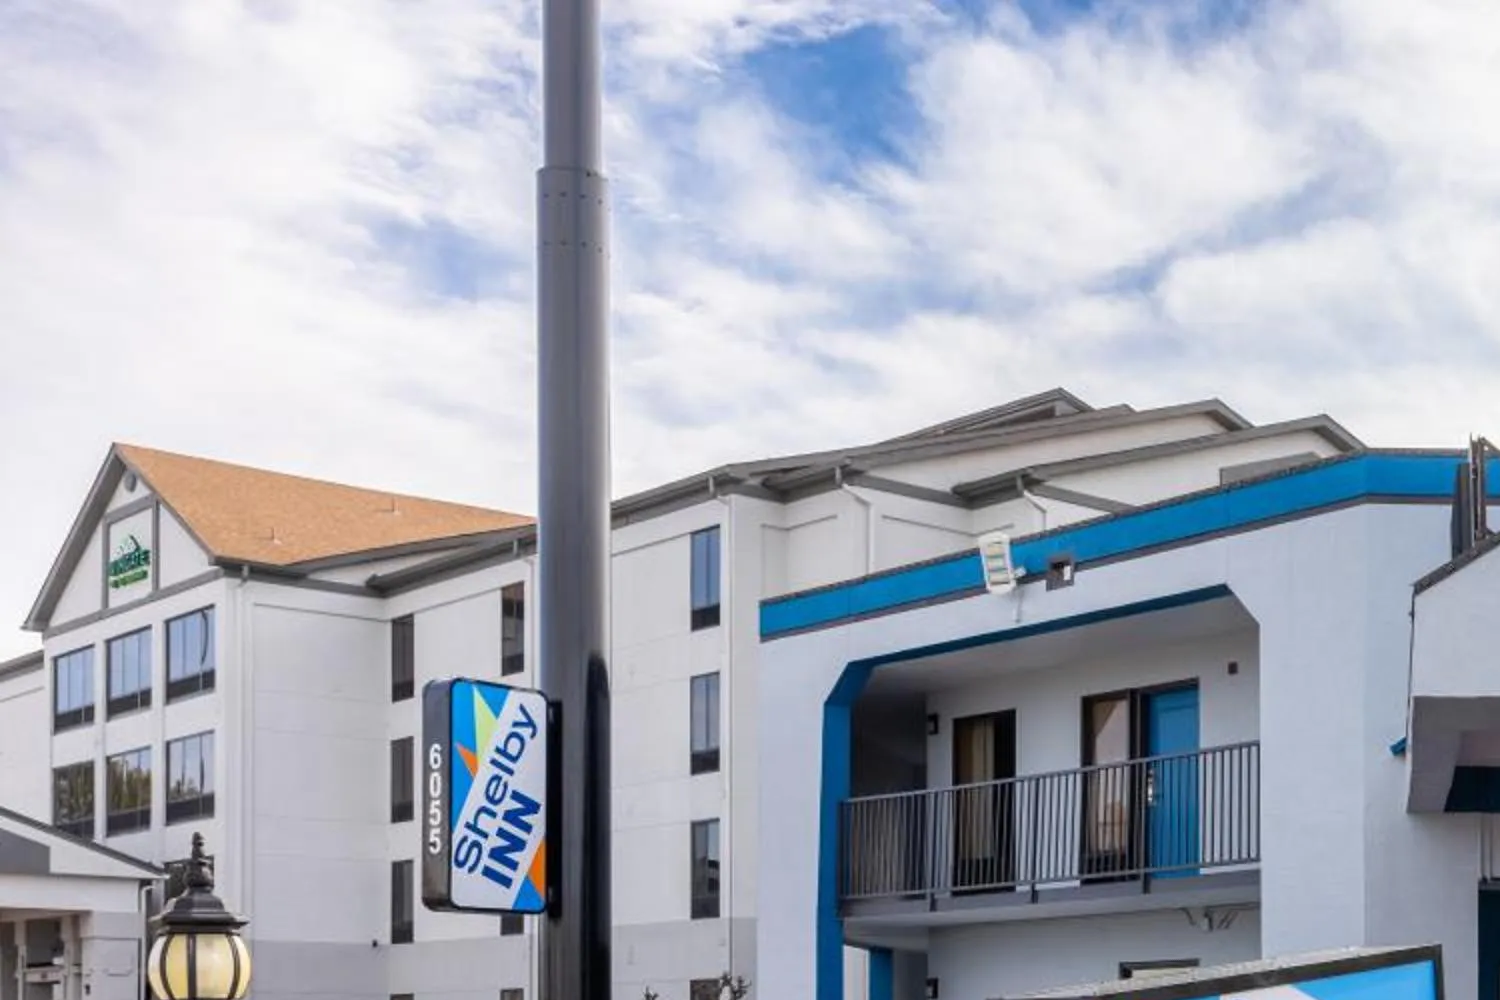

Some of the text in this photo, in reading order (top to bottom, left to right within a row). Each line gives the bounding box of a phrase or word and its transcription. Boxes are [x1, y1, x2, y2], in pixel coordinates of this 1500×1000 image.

[428, 744, 442, 854] 6055
[454, 704, 537, 874] Shelby
[481, 790, 542, 889] INN
